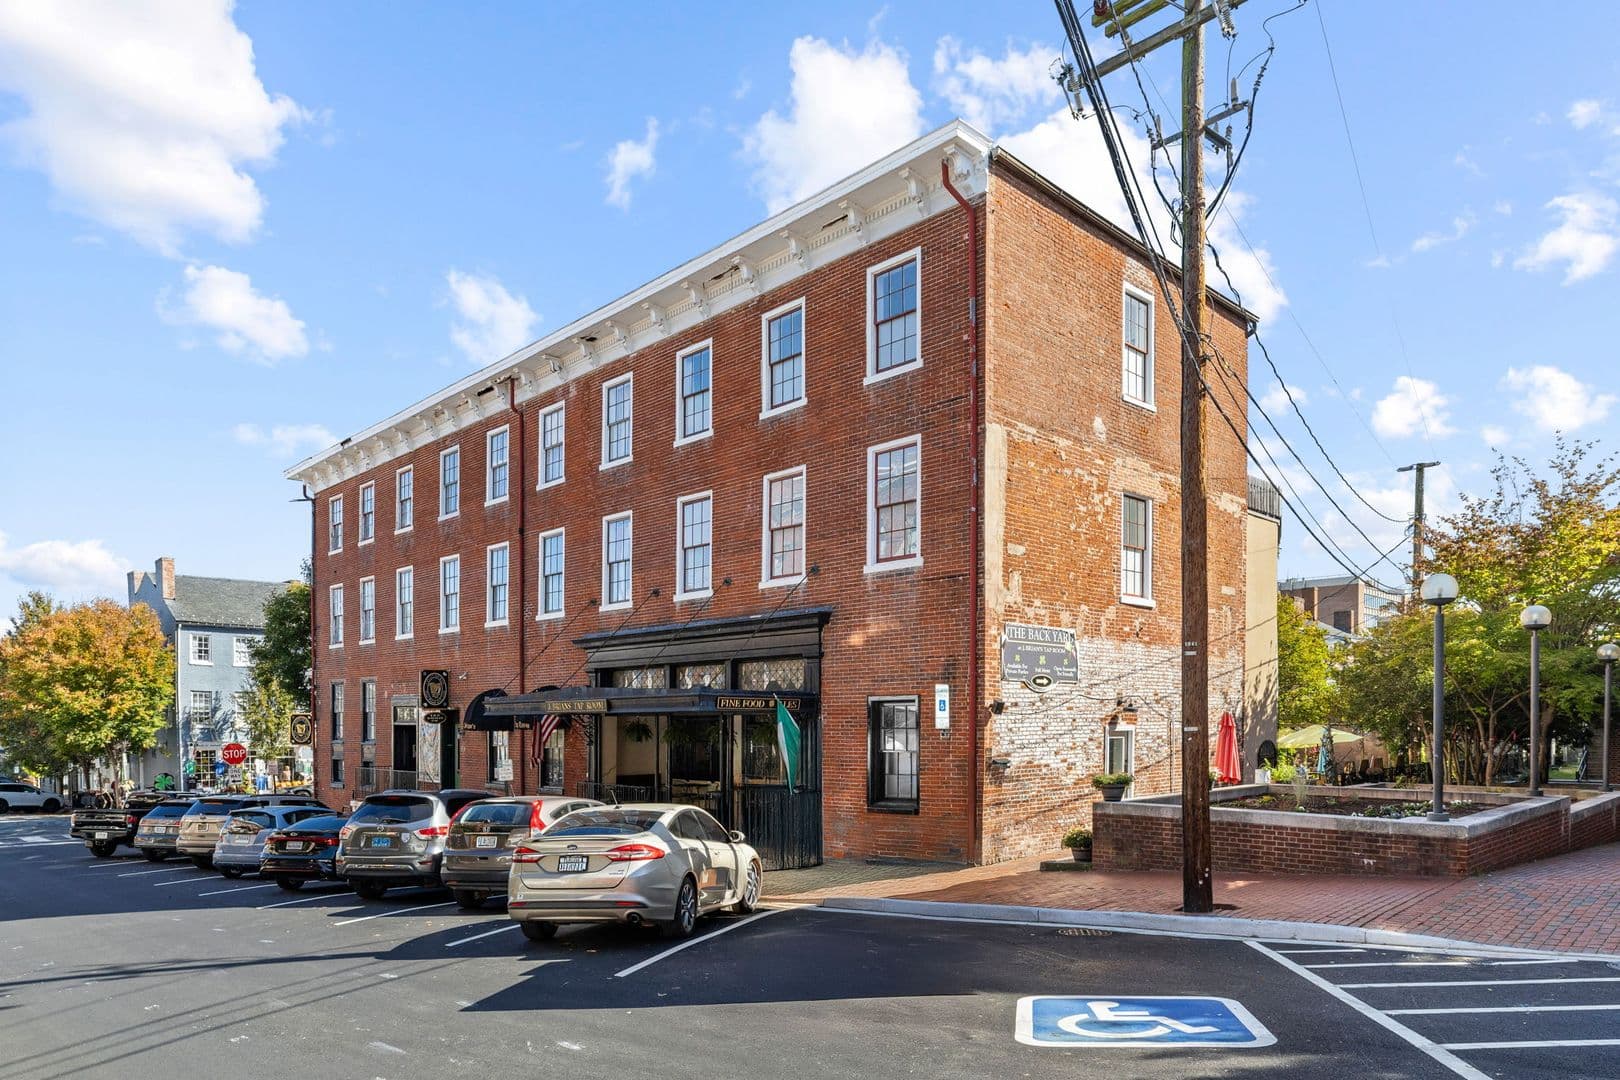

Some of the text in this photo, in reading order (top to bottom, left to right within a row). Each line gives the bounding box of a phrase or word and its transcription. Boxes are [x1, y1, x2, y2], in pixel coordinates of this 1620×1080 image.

[1008, 626, 1026, 639] THE
[1028, 628, 1052, 641] BACK
[720, 699, 740, 708] FINE
[742, 700, 766, 708] FOOD
[224, 750, 246, 758] STOP
